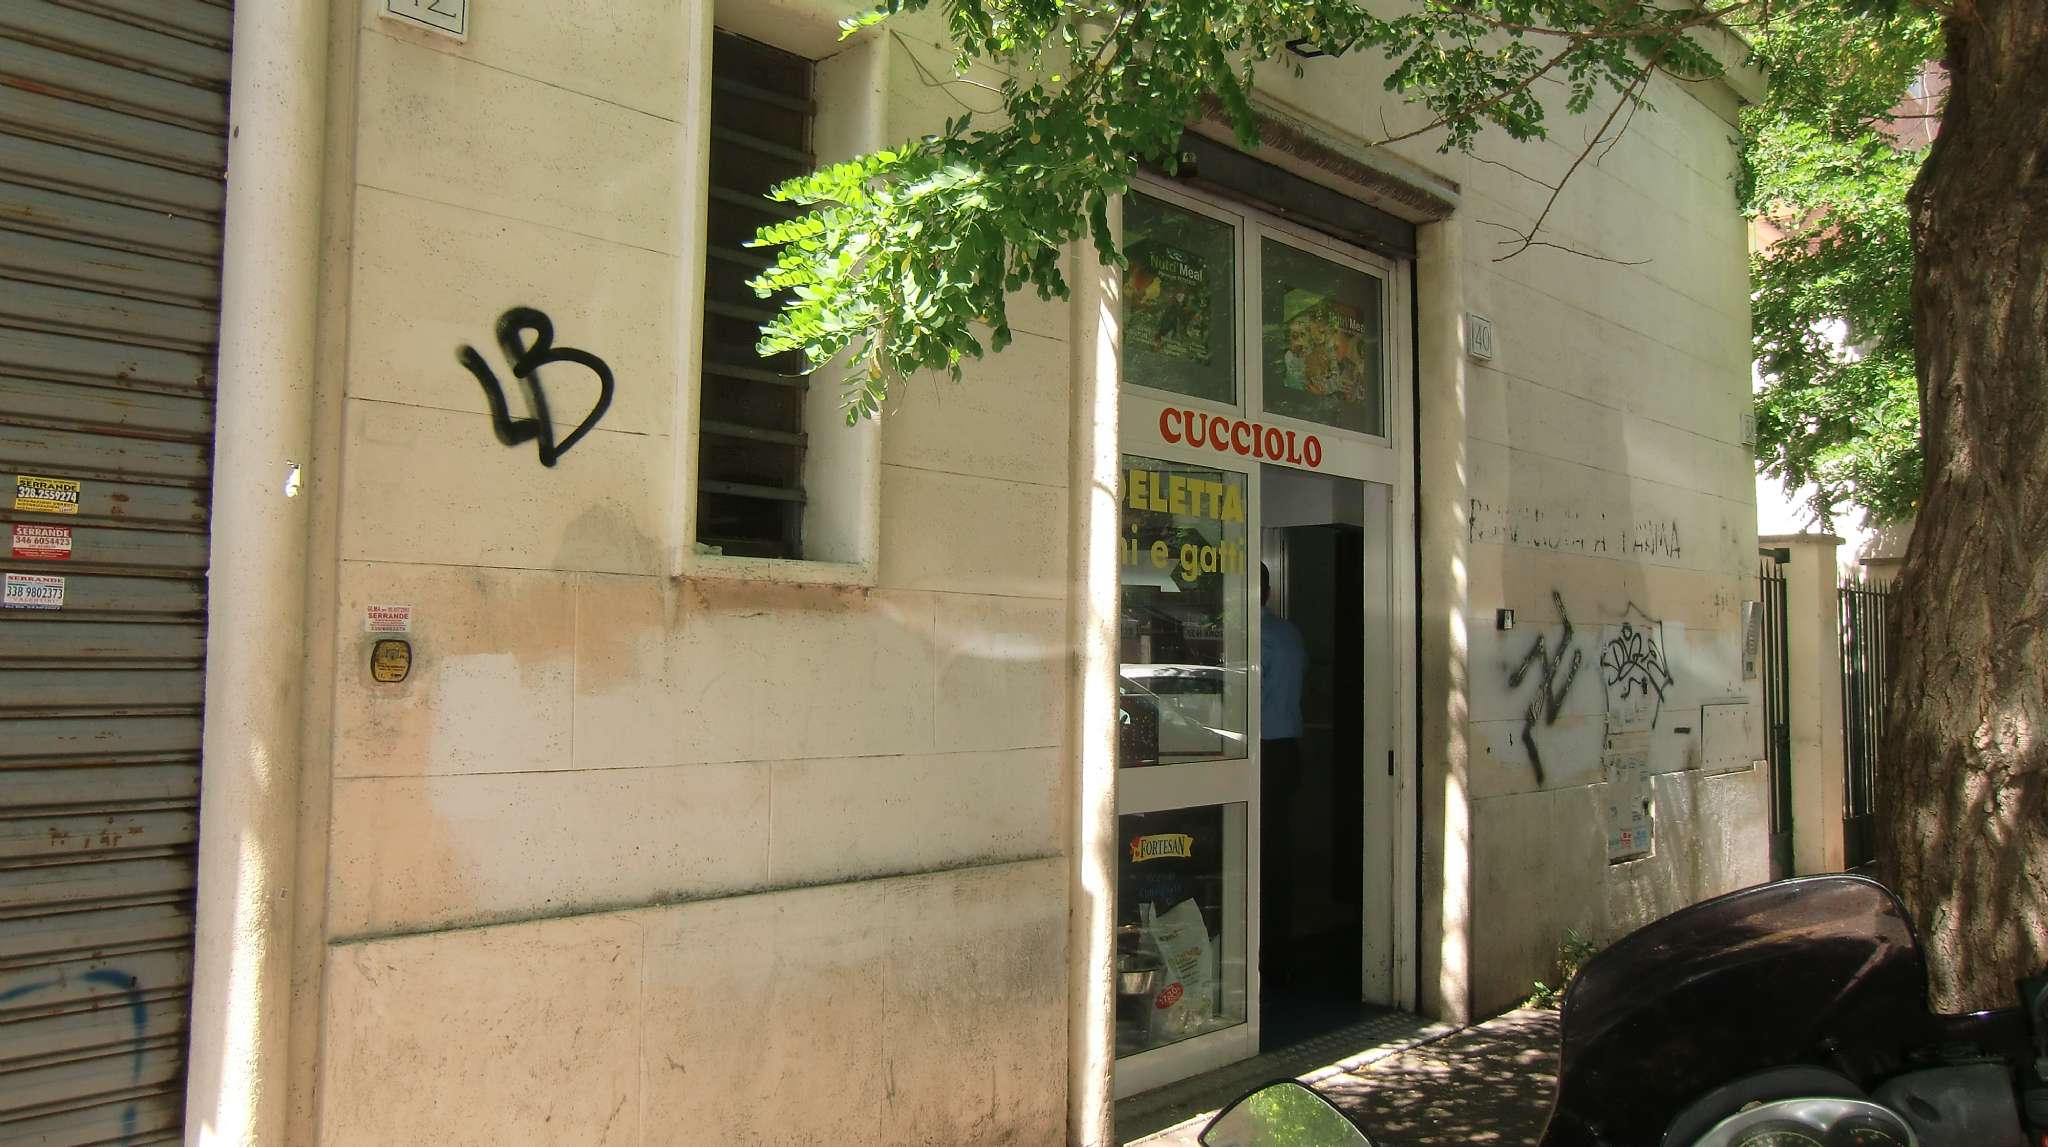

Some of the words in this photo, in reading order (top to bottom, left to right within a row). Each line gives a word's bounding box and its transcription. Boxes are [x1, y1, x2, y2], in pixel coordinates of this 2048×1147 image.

[1475, 325, 1490, 352] 40
[1159, 407, 1322, 468] CUCCIOLO
[19, 480, 77, 491] SERRANDE
[1120, 468, 1245, 523] ELETTA
[16, 527, 70, 538] SERRANDE
[1151, 540, 1168, 569] e
[8, 575, 63, 583] SERRANDE
[7, 585, 23, 597] 338
[26, 587, 63, 599] 9802373
[367, 612, 409, 620] SERRANDE
[1140, 836, 1185, 858] FORTESAN
